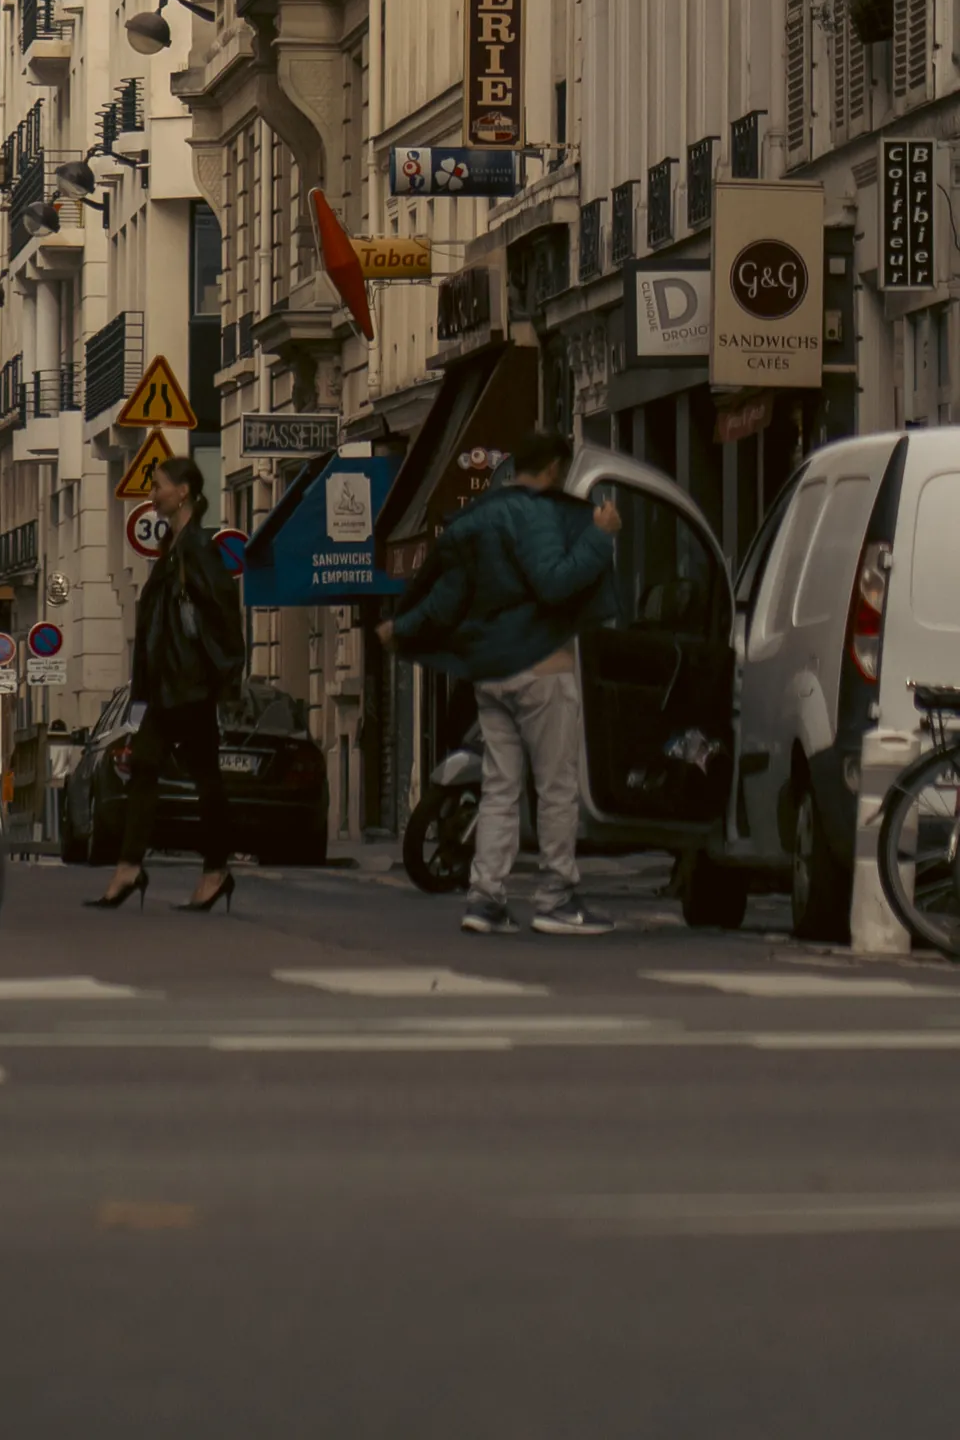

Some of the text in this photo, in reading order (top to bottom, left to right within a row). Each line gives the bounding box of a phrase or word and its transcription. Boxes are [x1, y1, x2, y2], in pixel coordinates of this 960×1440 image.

[888, 147, 904, 283] Coiffeur
[912, 147, 929, 283] Barbier
[361, 248, 427, 267] Tabac
[738, 261, 797, 299] G&G
[641, 281, 658, 333] CLINIQUE
[662, 324, 709, 342] DROUO
[719, 334, 818, 350] SANDWICHS
[747, 356, 790, 370] CAFÉS
[245, 423, 335, 448] BRASSERIE
[137, 519, 169, 541] 30
[312, 552, 372, 567] SANDWICHS
[312, 570, 372, 584] A EMPORTER
